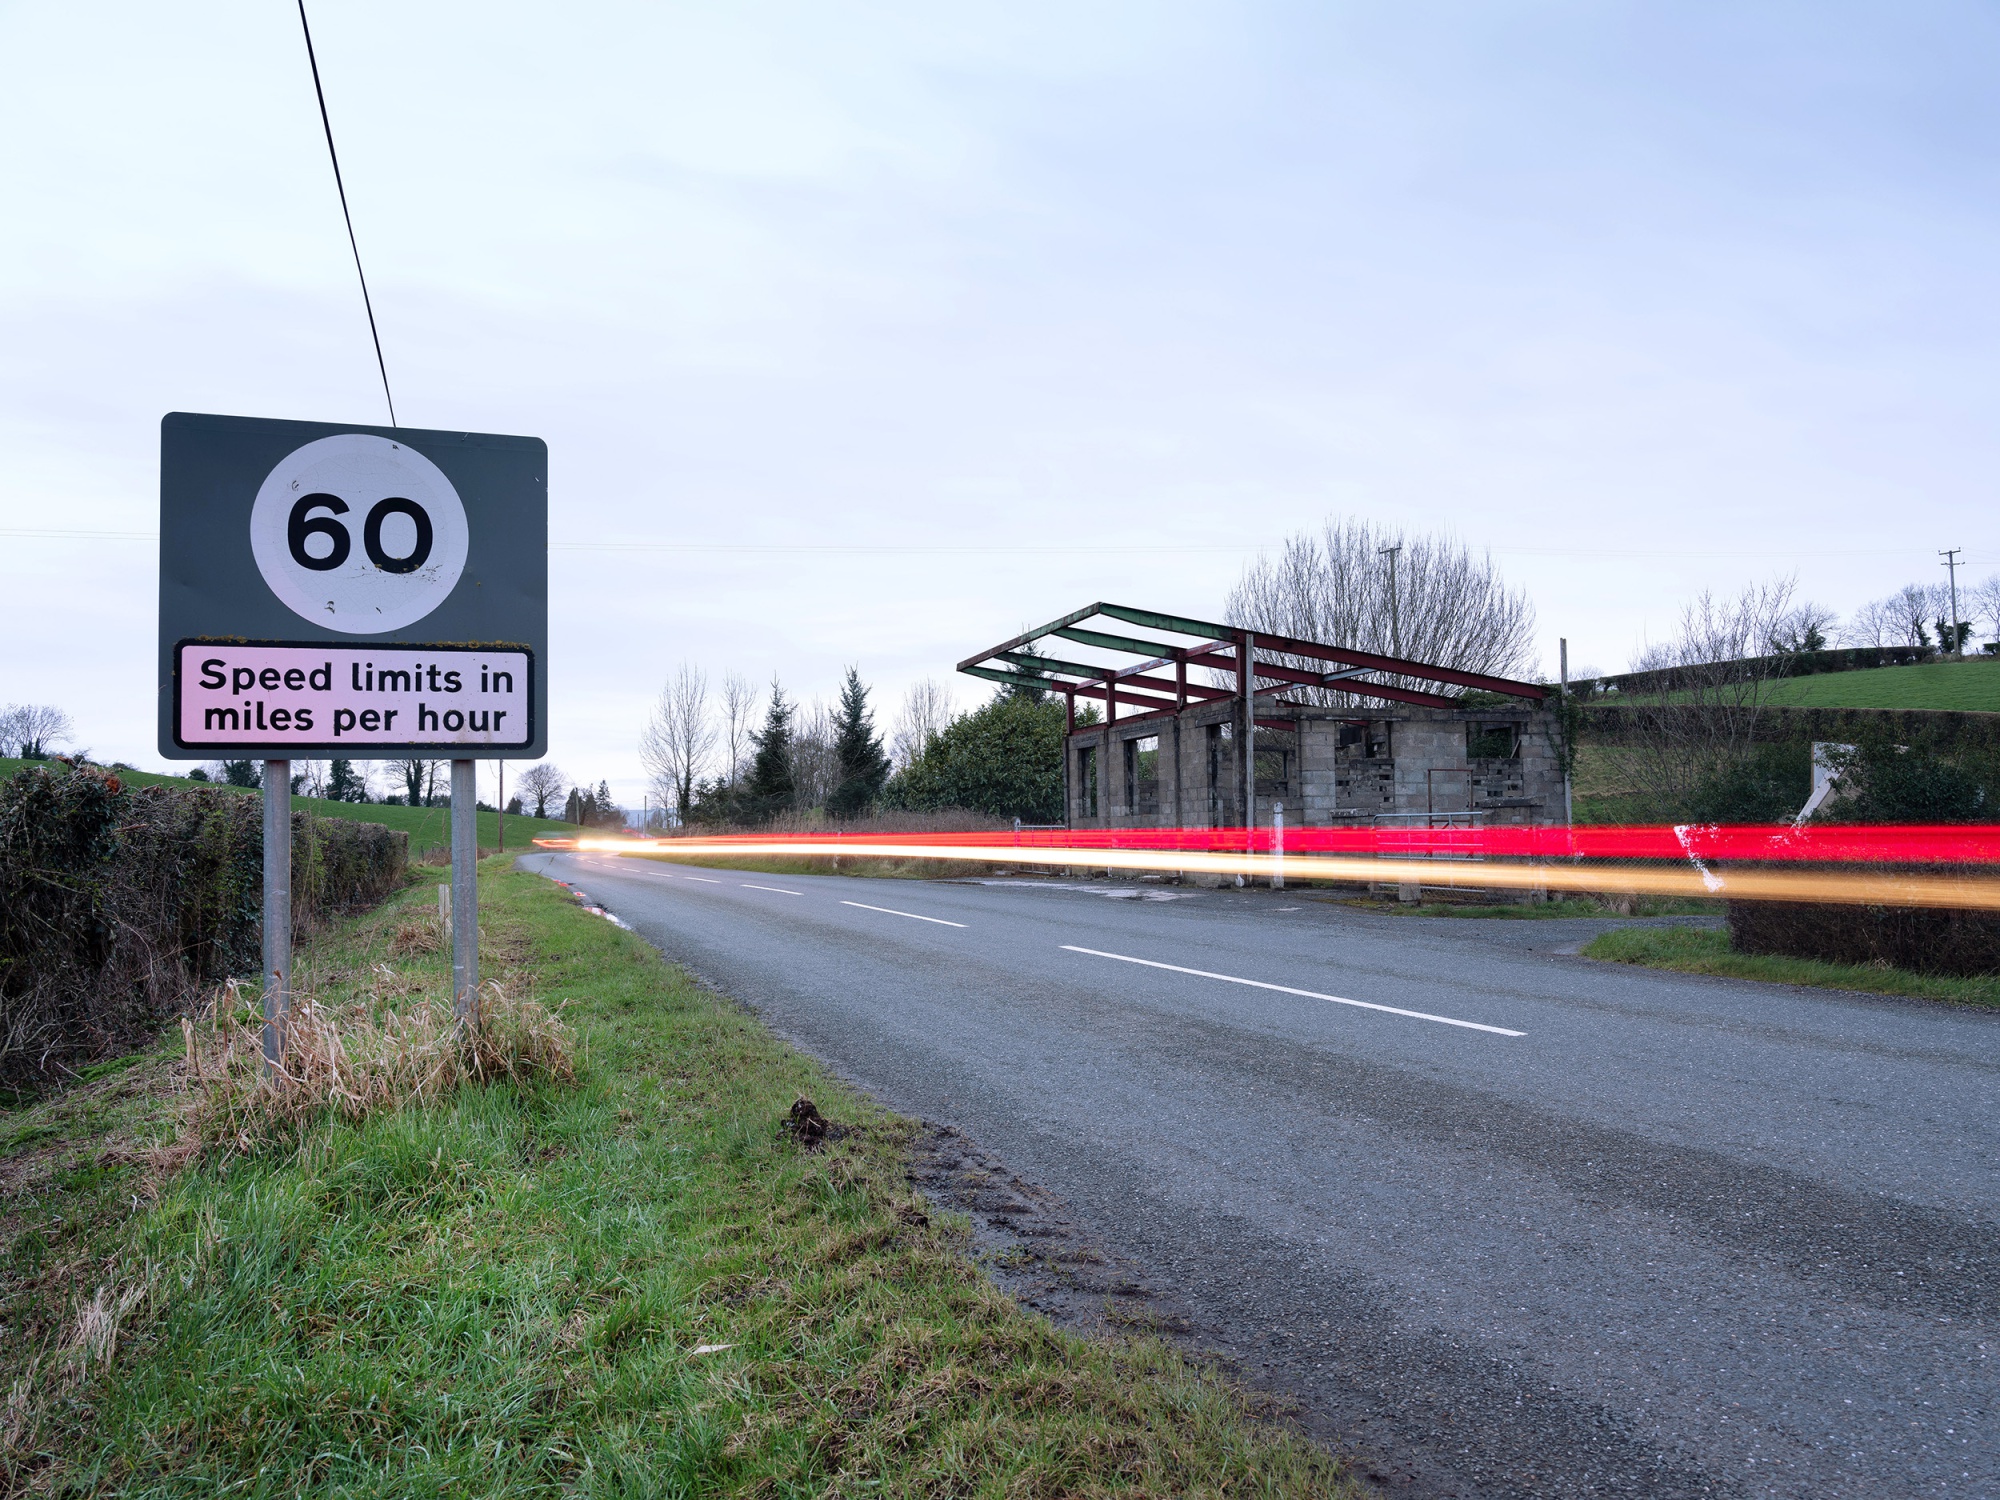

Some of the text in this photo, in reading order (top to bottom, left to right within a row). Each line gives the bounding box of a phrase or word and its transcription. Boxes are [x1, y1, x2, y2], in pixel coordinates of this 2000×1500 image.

[287, 492, 433, 574] 60
[199, 658, 513, 695] Speed limits in
[204, 701, 507, 737] miles per hour
